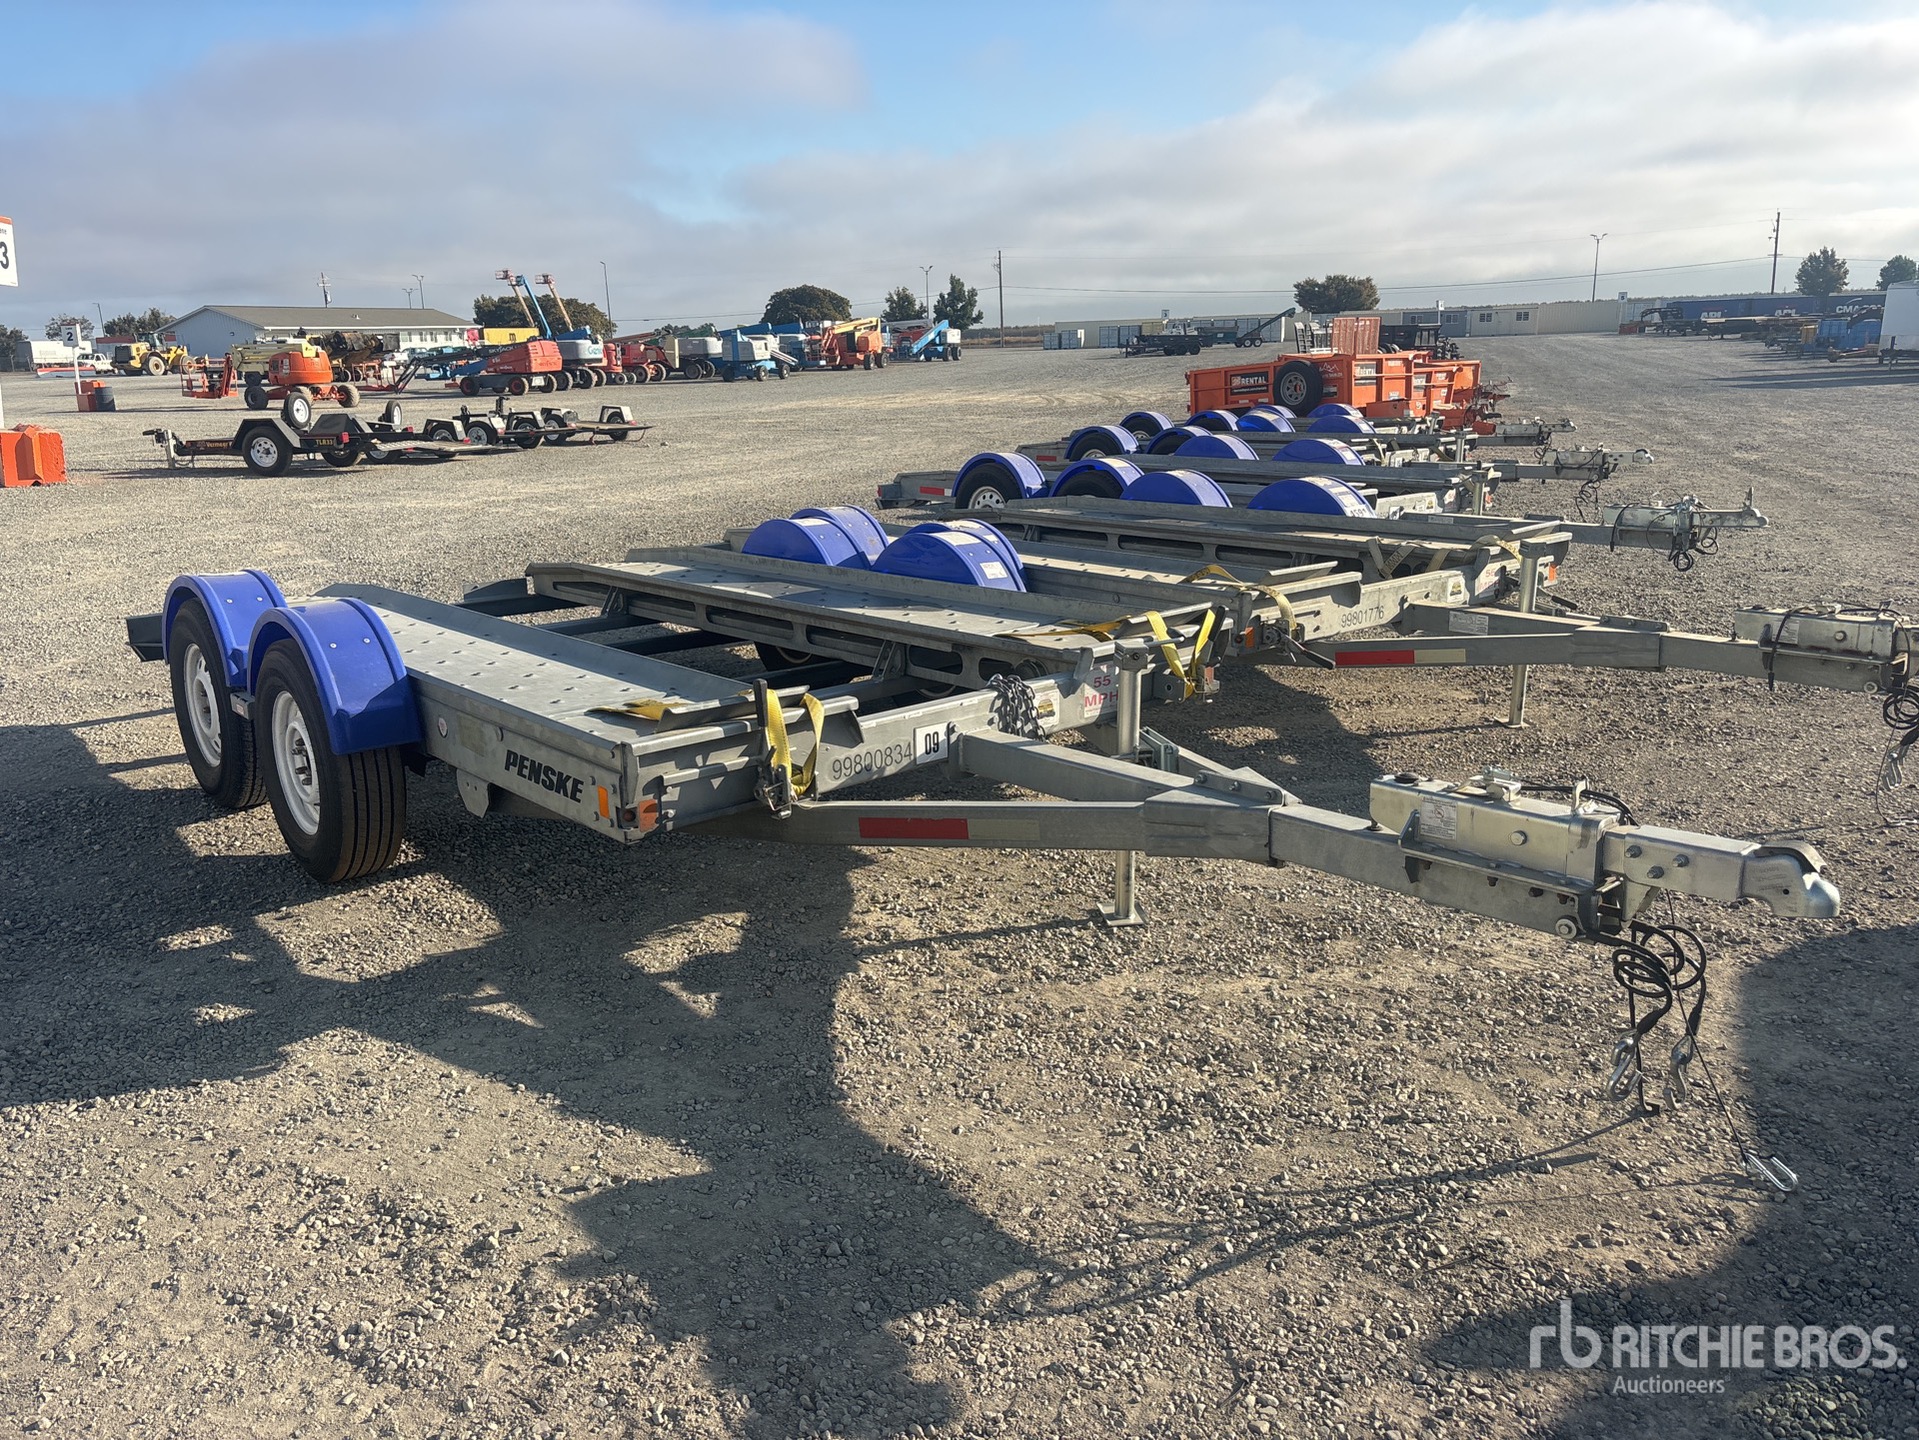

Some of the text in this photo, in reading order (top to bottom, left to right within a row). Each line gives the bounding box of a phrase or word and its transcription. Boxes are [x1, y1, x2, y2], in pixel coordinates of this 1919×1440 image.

[66, 331, 74, 342] 2
[1241, 376, 1267, 385] RENTAL
[1341, 605, 1385, 628] 99801776
[1094, 675, 1111, 688] 55
[1084, 690, 1119, 708] MPH
[924, 731, 940, 755] 09
[832, 741, 913, 780] 99800834
[504, 749, 585, 803] PENSKE
